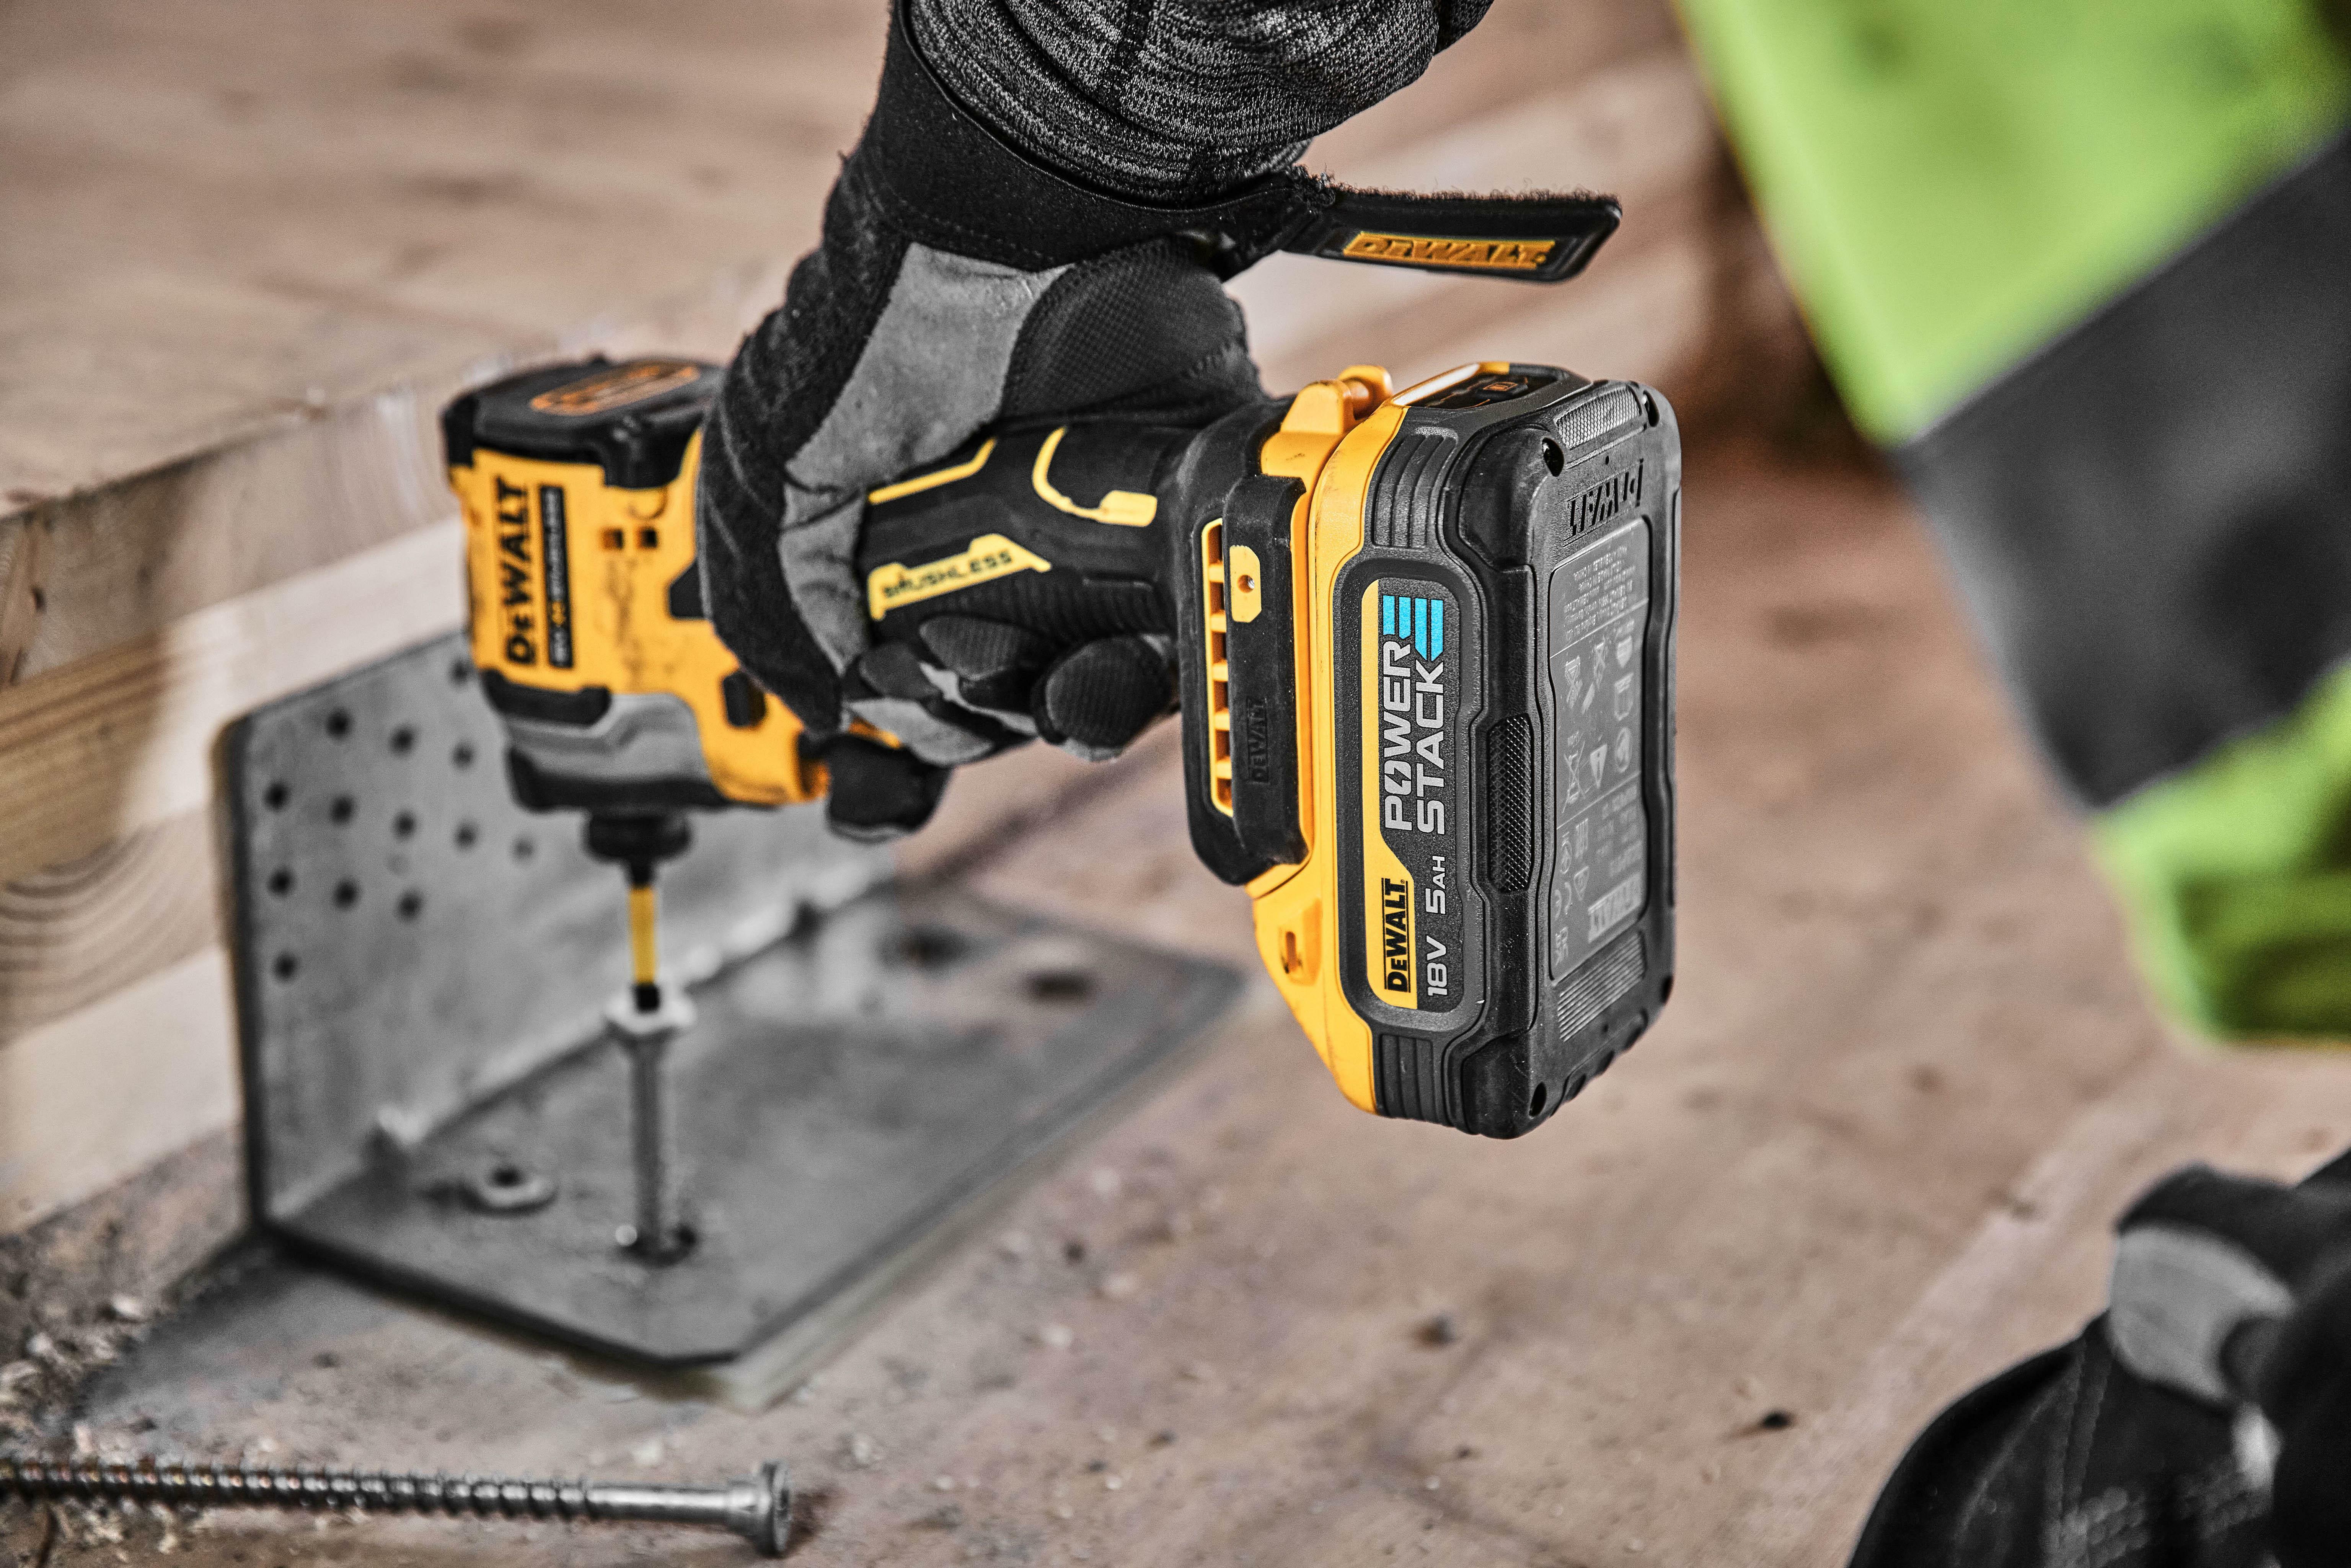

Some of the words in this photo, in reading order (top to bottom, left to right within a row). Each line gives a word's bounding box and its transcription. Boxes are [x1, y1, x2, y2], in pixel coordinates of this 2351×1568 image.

[1383, 641, 1412, 831] POWER
[1415, 661, 1445, 835] STACK
[1426, 936, 1447, 996] 18V
